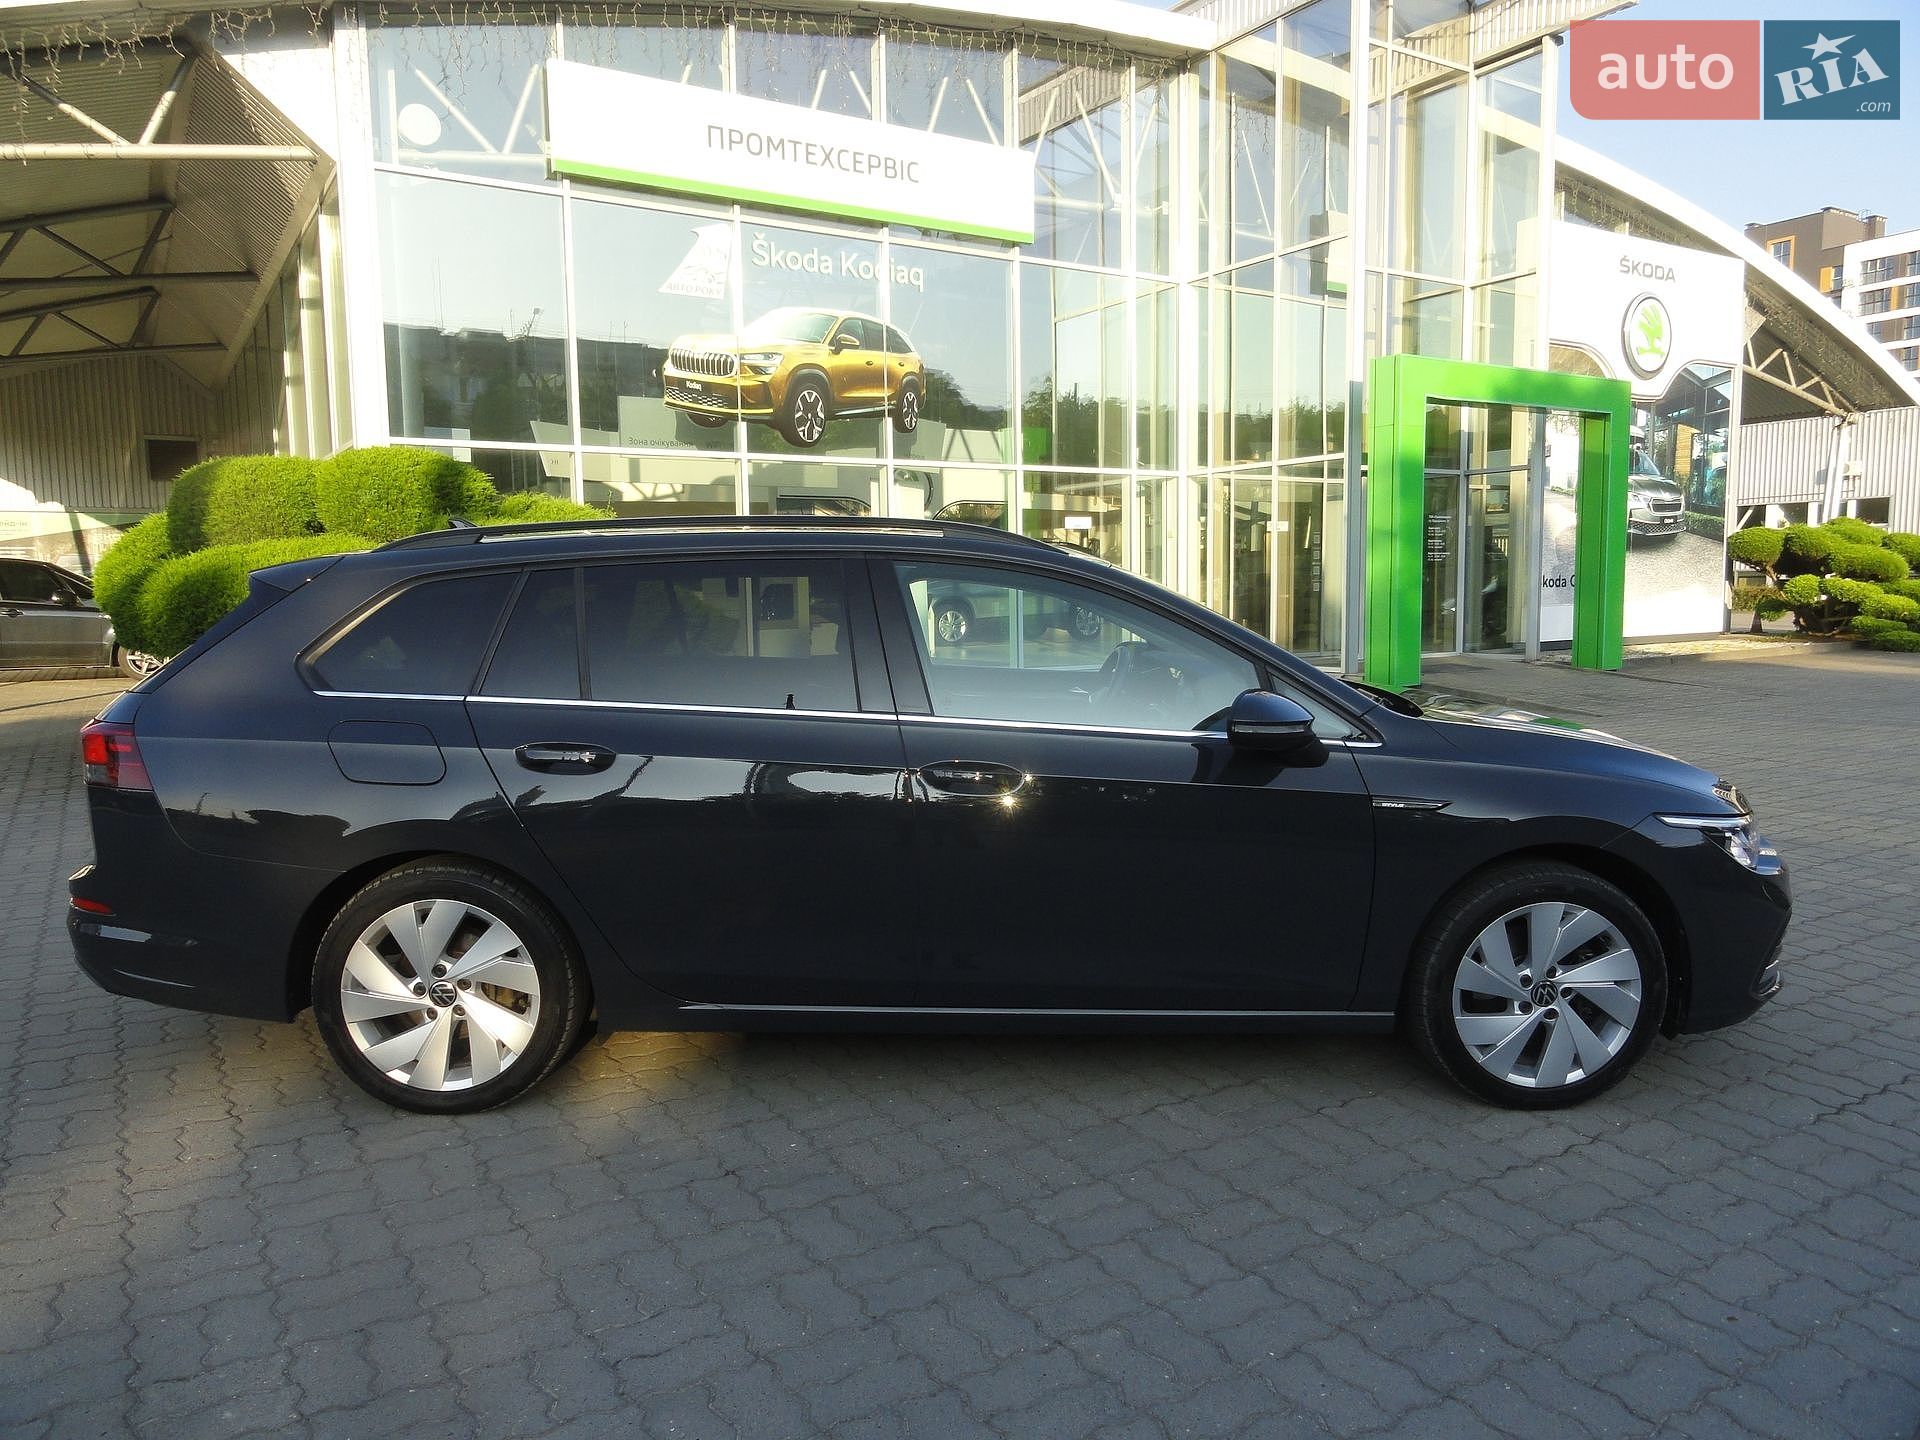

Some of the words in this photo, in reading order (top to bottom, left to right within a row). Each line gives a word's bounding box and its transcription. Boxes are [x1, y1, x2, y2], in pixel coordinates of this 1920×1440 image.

[707, 124, 920, 184] ПРОМТЕХСЕРВІС
[751, 231, 833, 276] Škoda
[1619, 254, 1676, 283] ŠKODA
[627, 436, 648, 446] Зона
[1542, 574, 1567, 588] koda
